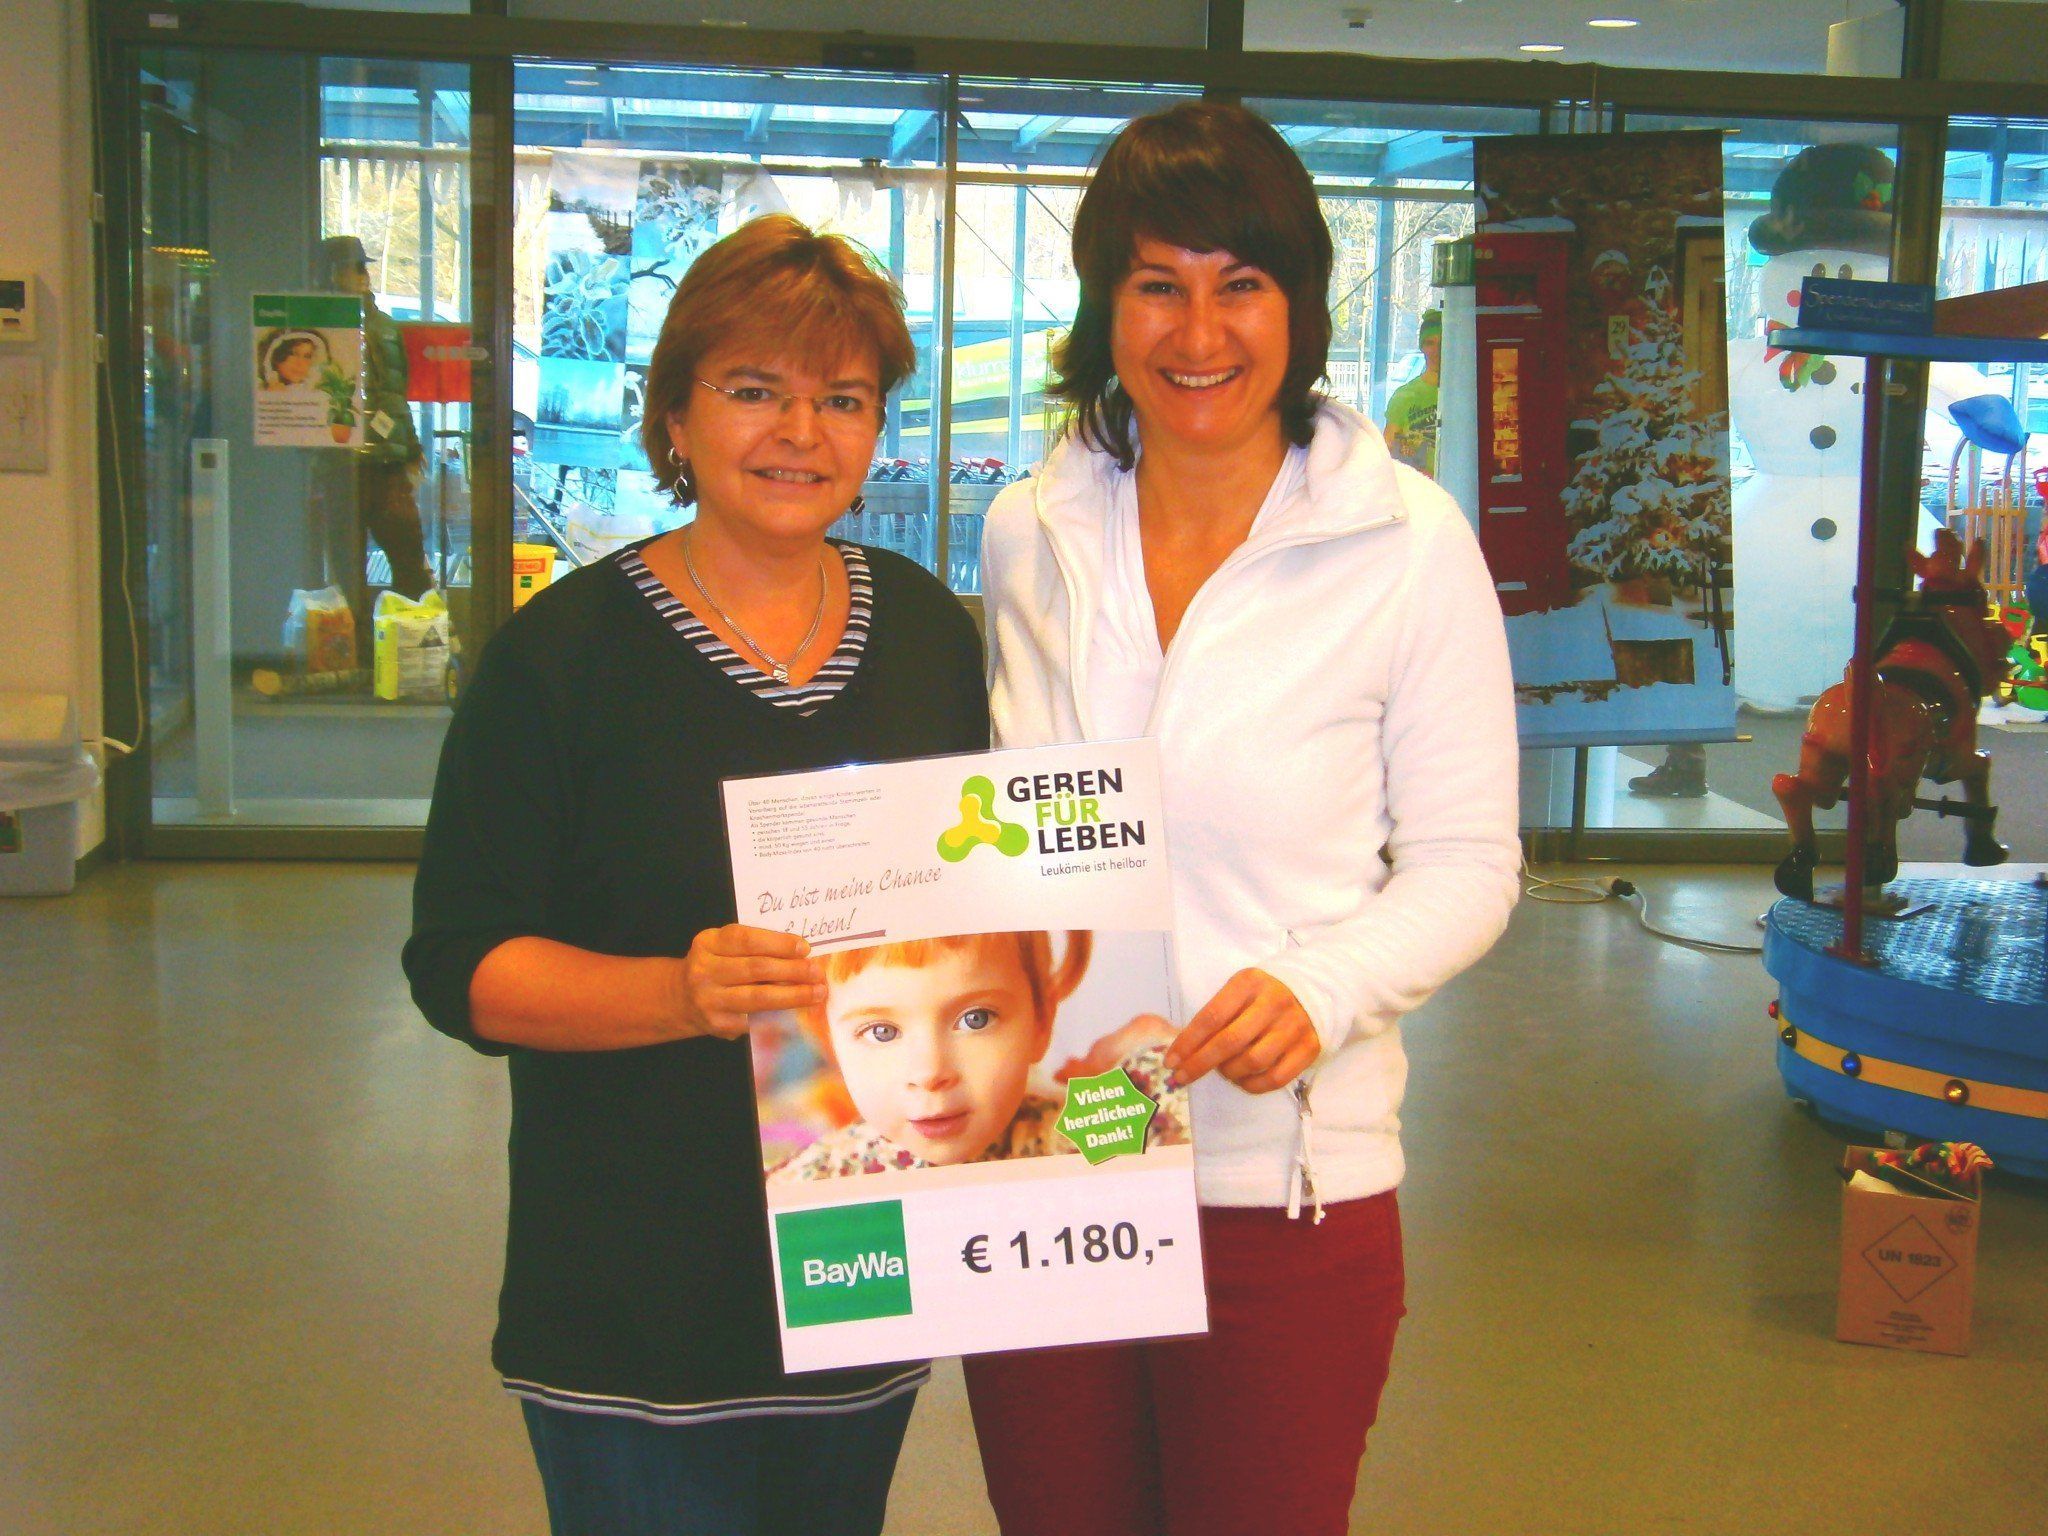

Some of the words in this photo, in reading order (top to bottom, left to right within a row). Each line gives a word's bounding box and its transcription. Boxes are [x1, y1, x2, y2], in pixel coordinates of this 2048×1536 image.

[1007, 768, 1123, 802] GEBEN
[1036, 792, 1101, 828] FÜR
[1038, 820, 1145, 854] LEBEN
[1041, 861, 1091, 877] Leukämie
[1094, 861, 1107, 872] ist
[1109, 857, 1147, 870] heilbar
[758, 890, 783, 915] Du
[790, 886, 820, 909] bist
[825, 877, 873, 902] meine
[879, 867, 941, 891] Chance
[801, 908, 857, 939] Leben!
[1074, 1085, 1125, 1106] Vielen
[1063, 1102, 1146, 1131] herzlichen
[1085, 1125, 1134, 1148] Dank!
[961, 1234, 992, 1274] €
[1010, 1221, 1174, 1269] 1.180,-
[1879, 1249, 1902, 1263] UN
[803, 1251, 904, 1288] BayWa
